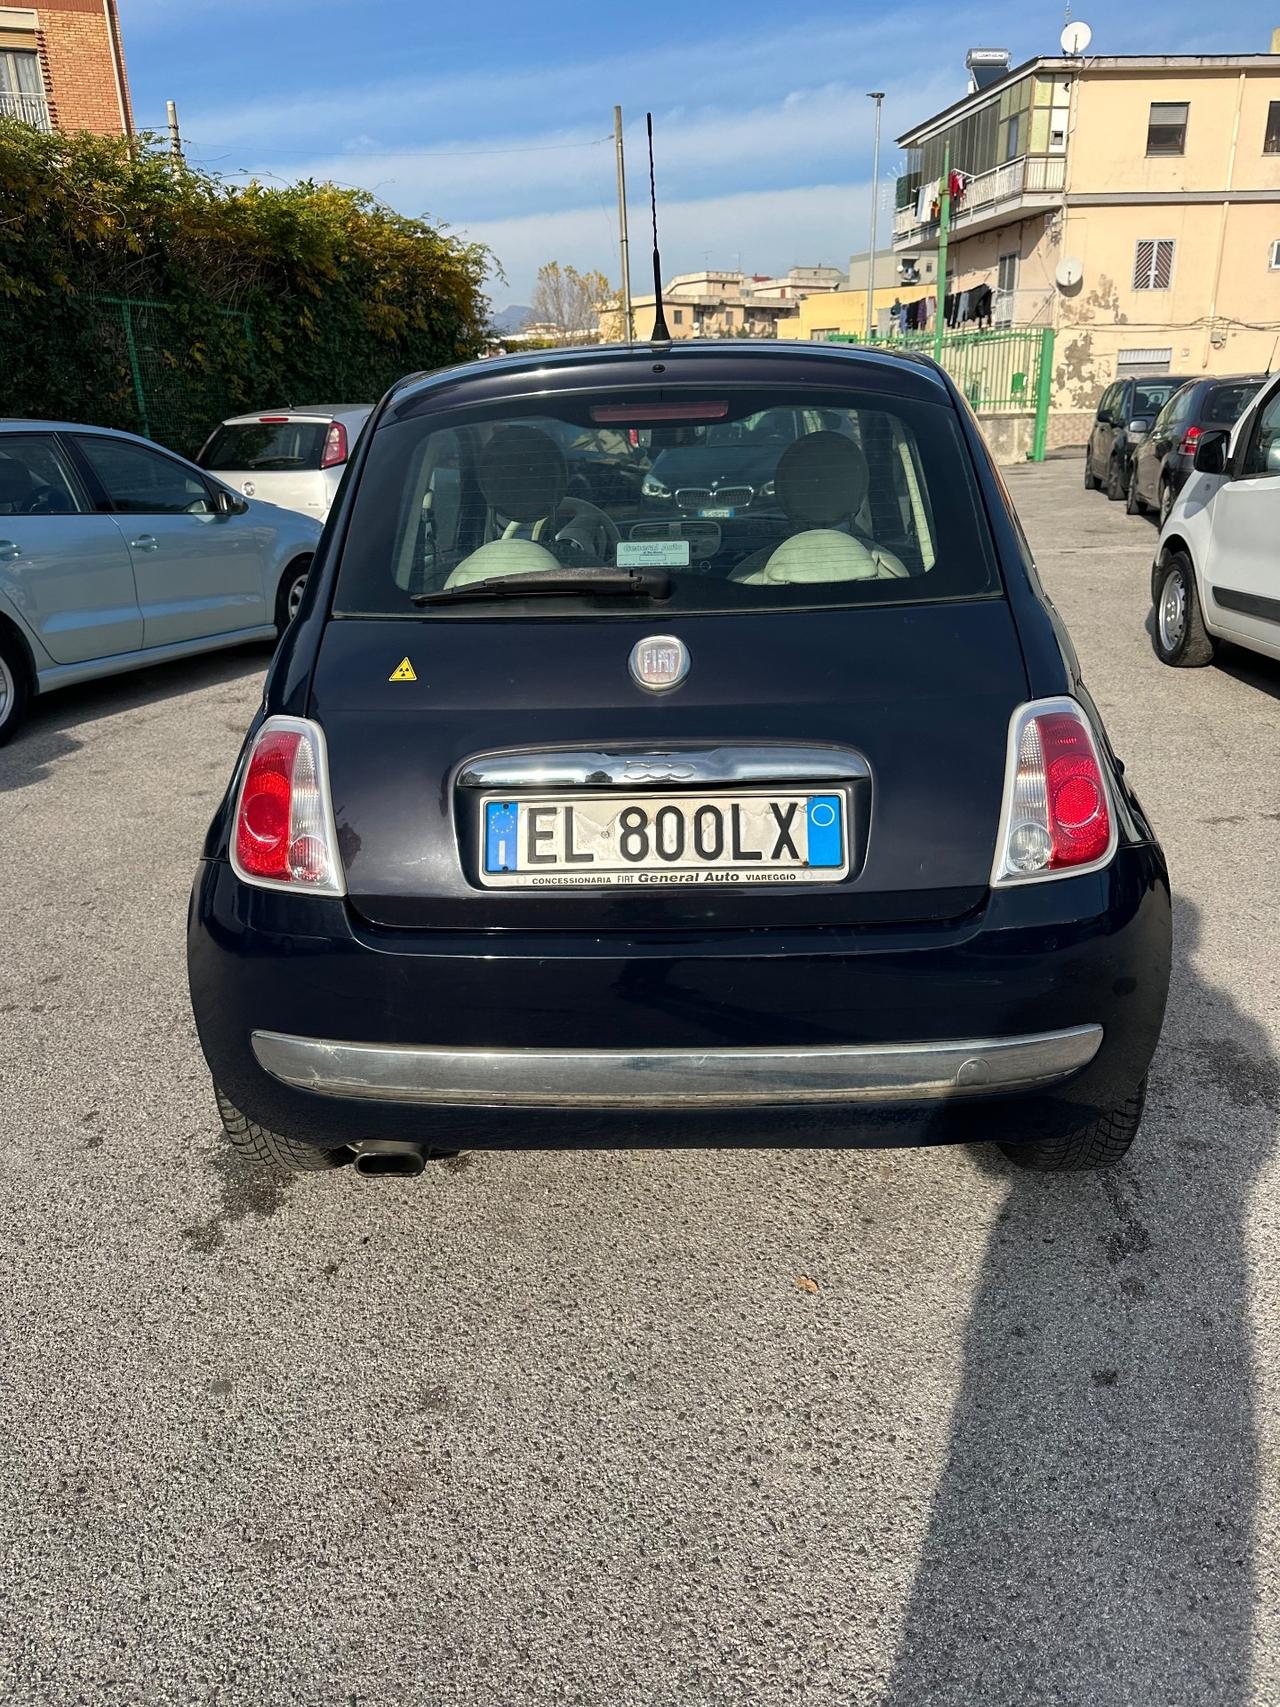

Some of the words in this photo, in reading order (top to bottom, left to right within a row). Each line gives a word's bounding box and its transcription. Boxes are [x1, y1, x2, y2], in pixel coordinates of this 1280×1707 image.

[644, 649, 678, 673] FIAT
[624, 761, 696, 780] 500
[527, 806, 594, 864] EL
[532, 877, 612, 885] CONCESSIONARIA
[617, 875, 634, 884] FIAT
[638, 873, 699, 883] General
[704, 872, 740, 882] Auto
[745, 873, 796, 881] VIAREGGIO
